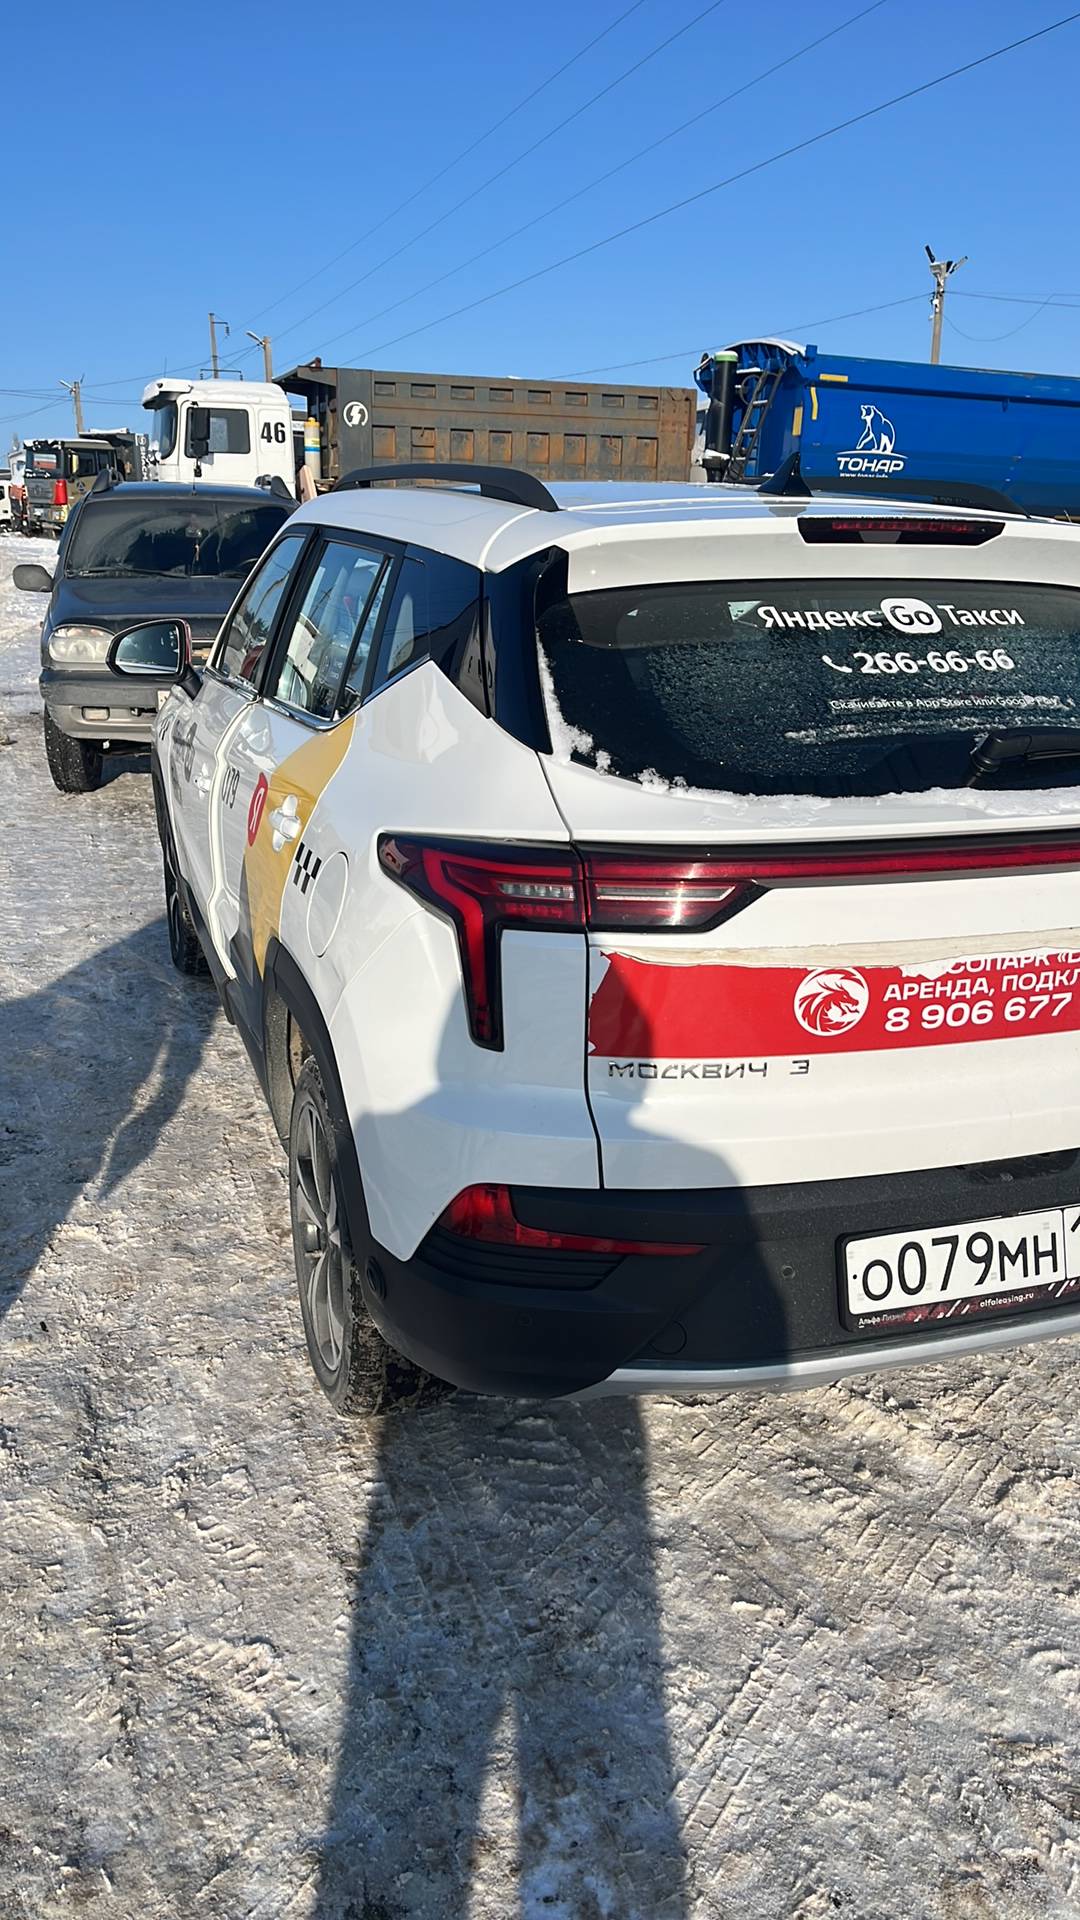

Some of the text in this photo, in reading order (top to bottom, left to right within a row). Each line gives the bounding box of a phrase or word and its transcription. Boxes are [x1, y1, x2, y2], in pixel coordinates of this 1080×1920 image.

[260, 421, 286, 443] 46
[837, 457, 904, 473] ТОНАР
[757, 605, 1025, 630] Яндекс Go Такси
[853, 649, 1014, 674] 266-66-66
[829, 698, 904, 709] Скачивайте
[916, 698, 940, 709] App
[941, 697, 972, 708] Store
[946, 953, 1050, 975] СОПАРК
[883, 977, 995, 1002] АРЕНДА,
[885, 992, 1072, 1032] 8 906 677
[790, 1059, 809, 1075] 3
[980, 1292, 1034, 1308] alfaleasing.ru
